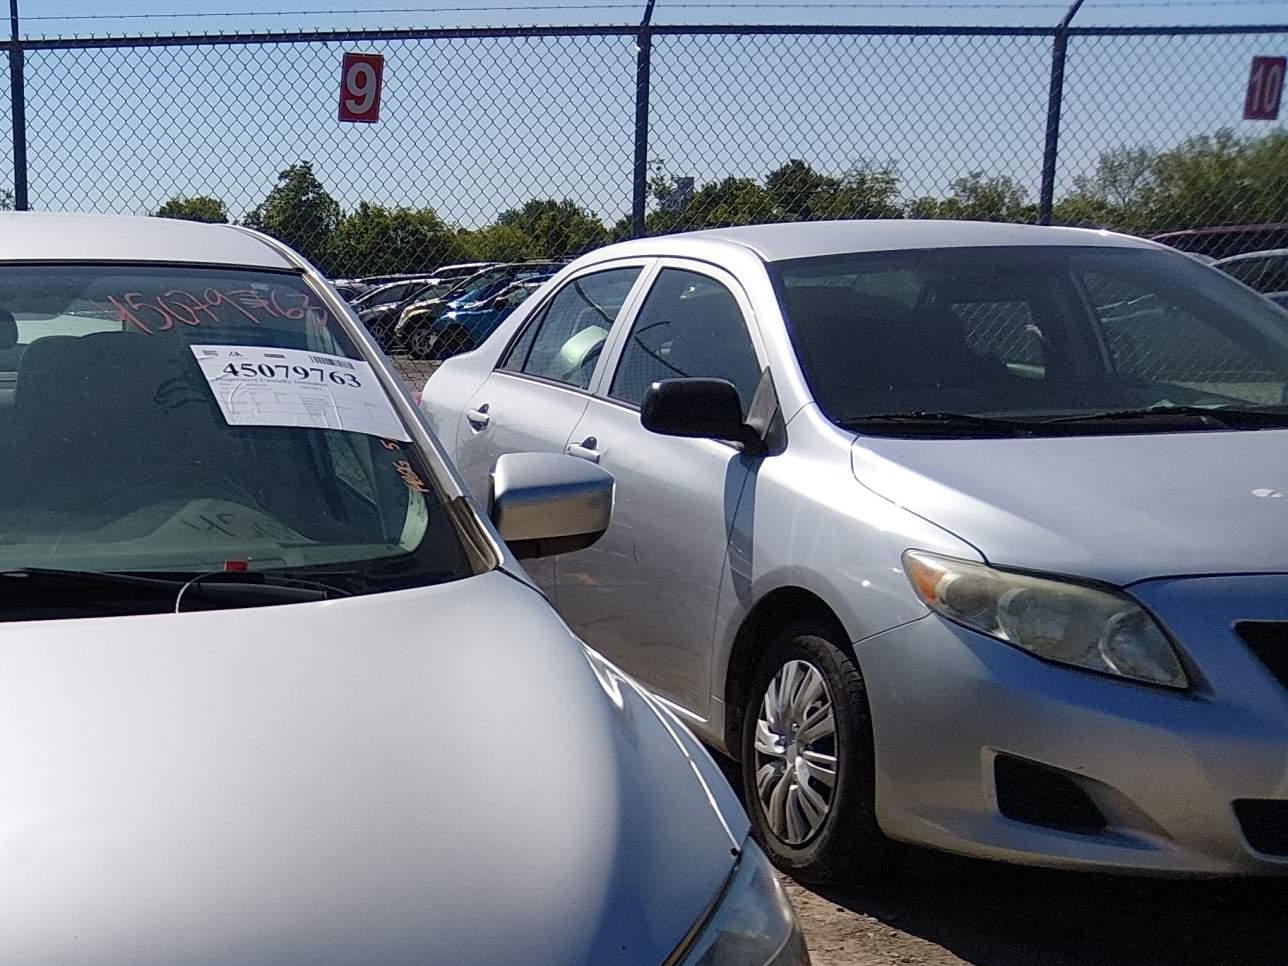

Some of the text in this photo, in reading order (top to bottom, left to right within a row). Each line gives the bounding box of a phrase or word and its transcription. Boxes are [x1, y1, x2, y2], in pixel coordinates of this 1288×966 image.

[345, 62, 377, 115] 9
[1252, 64, 1281, 113] 10
[222, 362, 362, 389] 45079763
